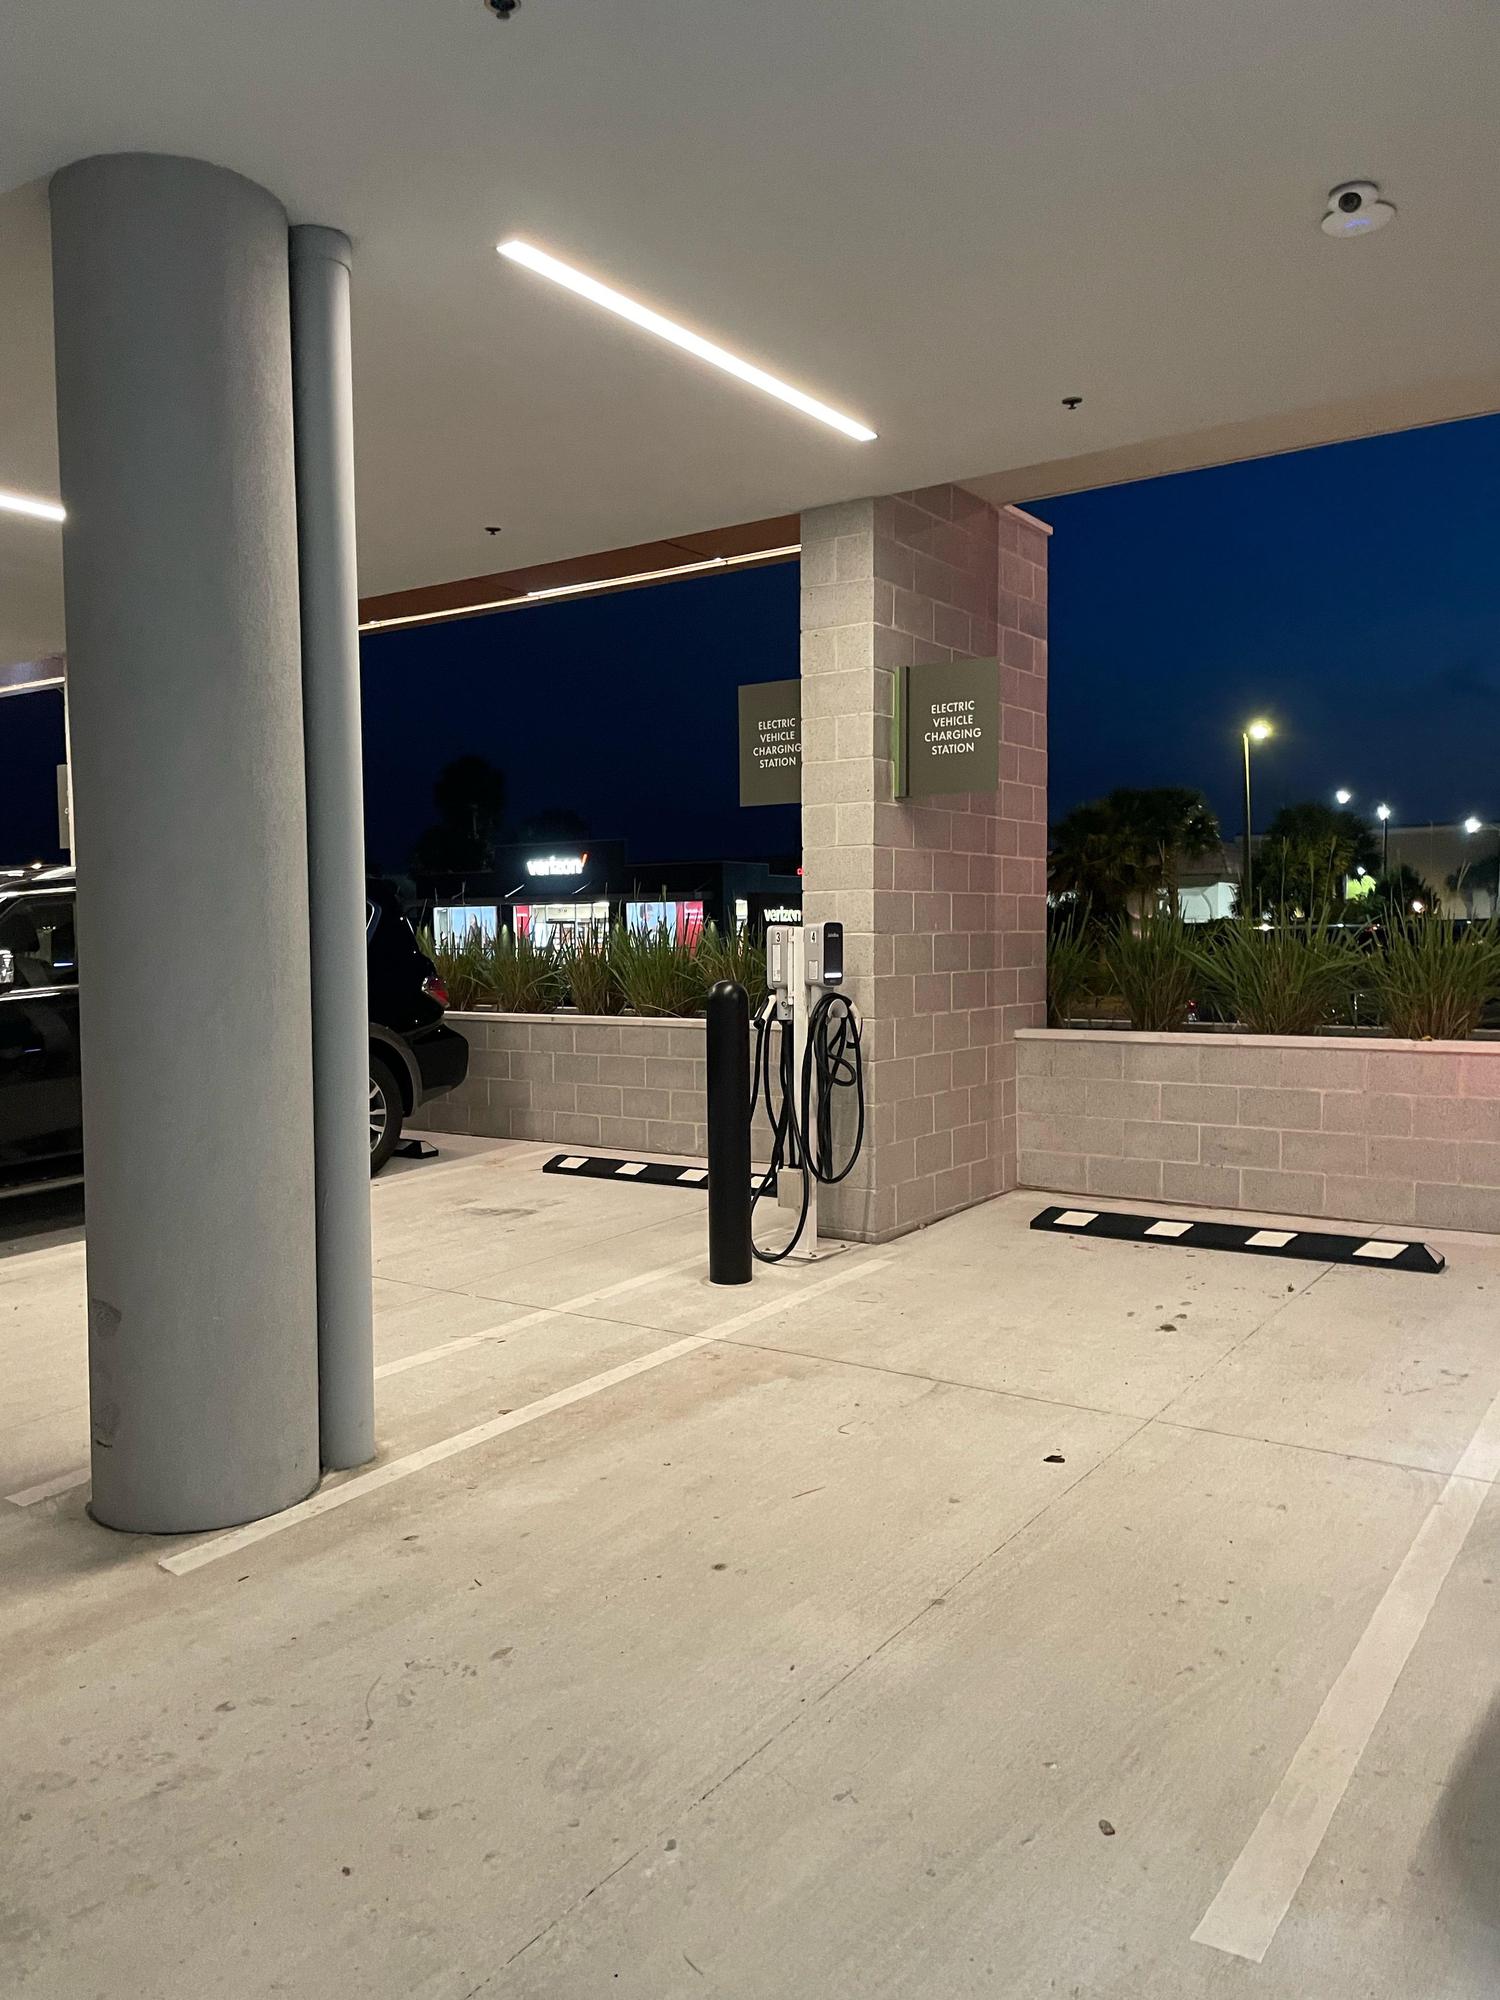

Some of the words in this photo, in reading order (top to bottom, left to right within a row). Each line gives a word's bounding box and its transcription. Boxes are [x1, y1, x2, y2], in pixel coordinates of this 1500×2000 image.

[931, 700, 975, 714] ELECTRIC
[758, 717, 796, 731] ELECTRIC
[933, 714, 973, 728] VEHICLE
[760, 730, 796, 743] VEHICLE
[924, 727, 982, 742] CHARGING
[752, 742, 802, 757] CHARGING
[931, 742, 975, 756] STATION
[759, 756, 797, 769] STATION
[526, 855, 584, 876] verizon
[763, 905, 802, 922] verizon
